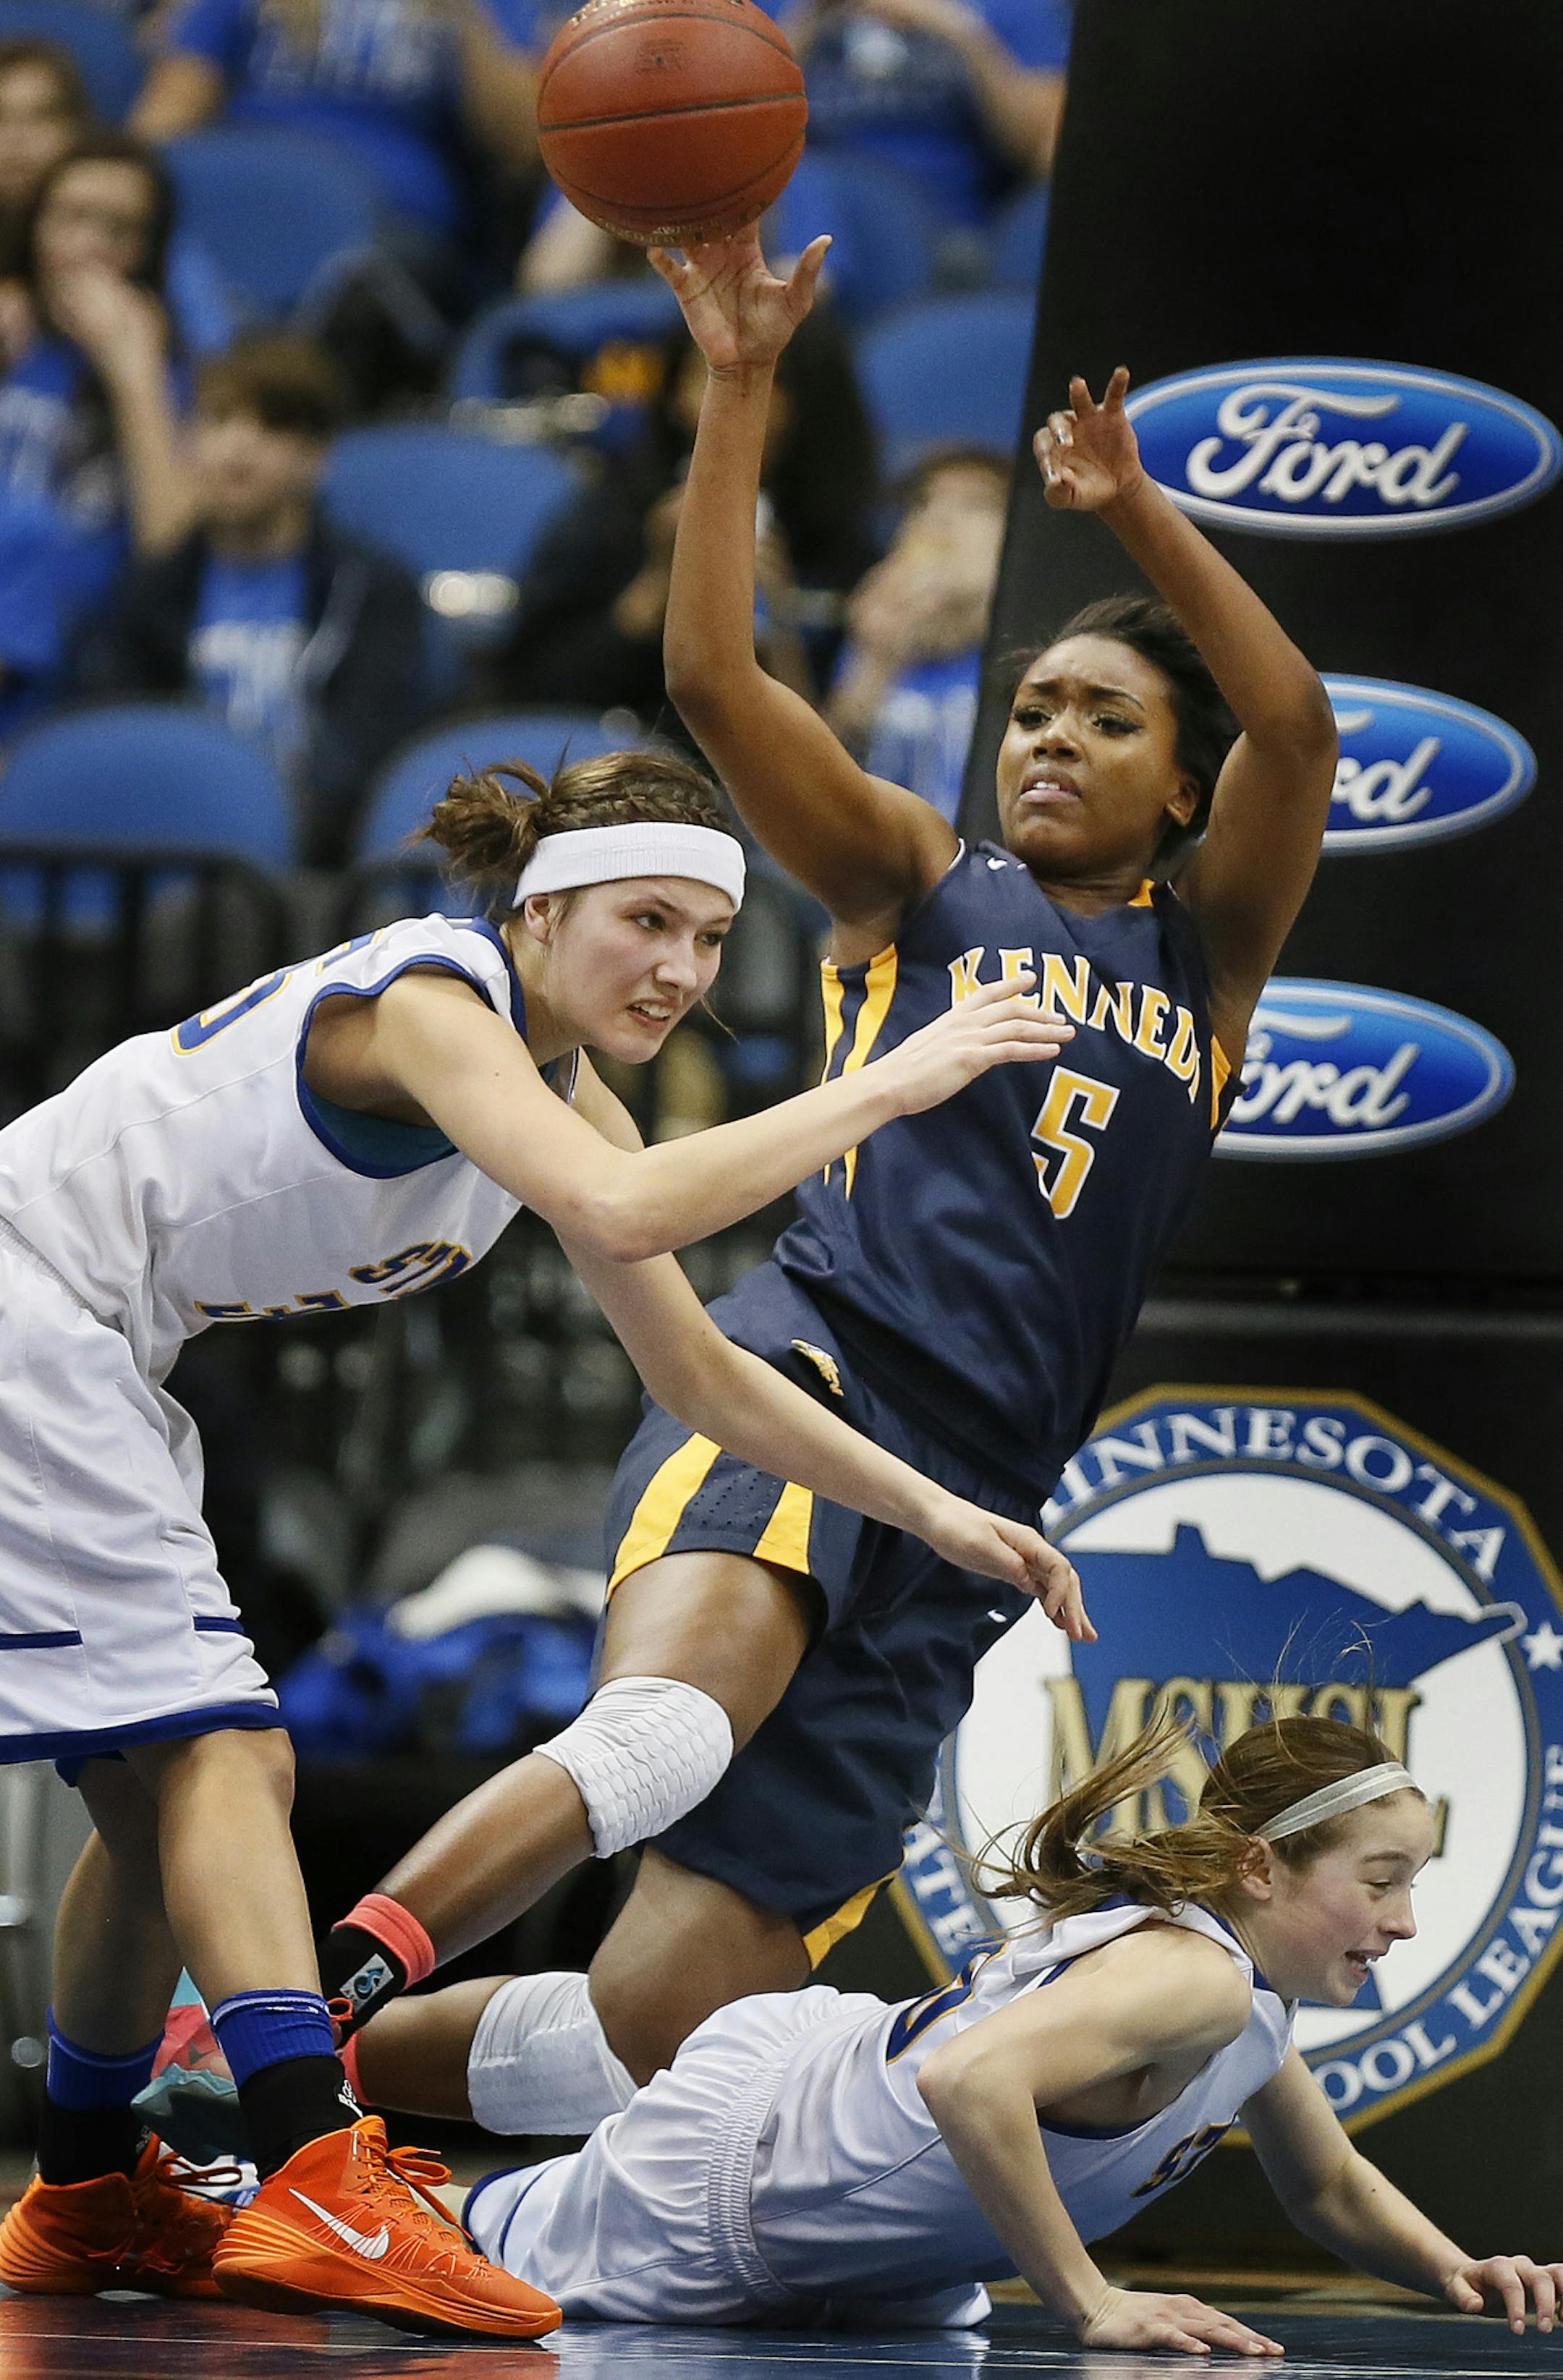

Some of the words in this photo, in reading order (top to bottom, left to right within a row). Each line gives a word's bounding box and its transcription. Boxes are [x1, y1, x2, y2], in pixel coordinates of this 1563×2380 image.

[1185, 382, 1469, 507] Ford
[947, 945, 1201, 1105] KENNED
[1030, 1065, 1121, 1220] 5
